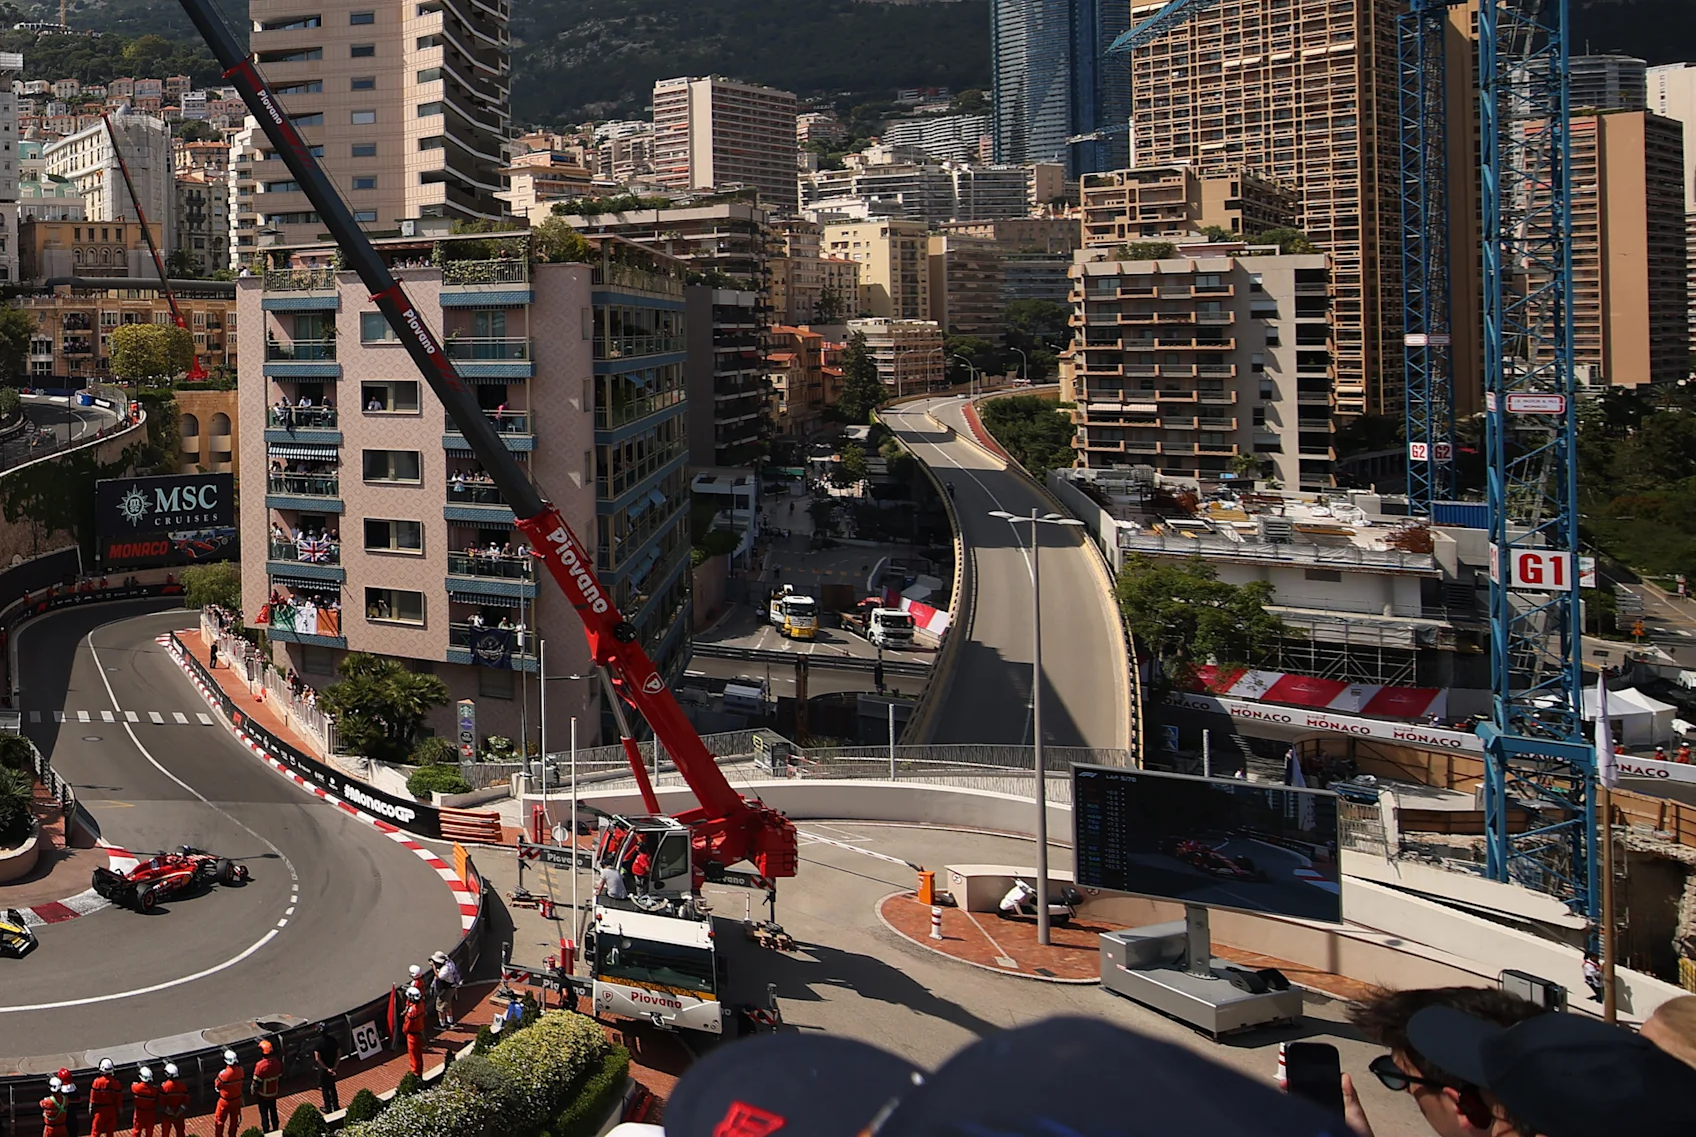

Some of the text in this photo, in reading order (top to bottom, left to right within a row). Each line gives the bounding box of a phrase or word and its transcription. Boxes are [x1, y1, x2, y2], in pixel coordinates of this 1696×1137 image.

[256, 89, 283, 125] Piovano
[403, 309, 436, 355] Piovano
[1412, 444, 1425, 458] G2
[1435, 445, 1451, 459] G2
[154, 485, 218, 513] MSC
[154, 513, 219, 526] CRUISES
[109, 541, 169, 559] MONACO
[546, 526, 609, 614] Piovano
[1519, 553, 1564, 586] G1
[1162, 697, 1210, 711] ONACO
[1230, 708, 1292, 723] MONACO
[1307, 719, 1371, 735] MONACO
[1393, 732, 1461, 748] MONACO
[344, 784, 416, 823] #MonacoGP
[547, 853, 583, 866] Piovao
[631, 991, 682, 1009] Piovano
[357, 1028, 378, 1053] SC
